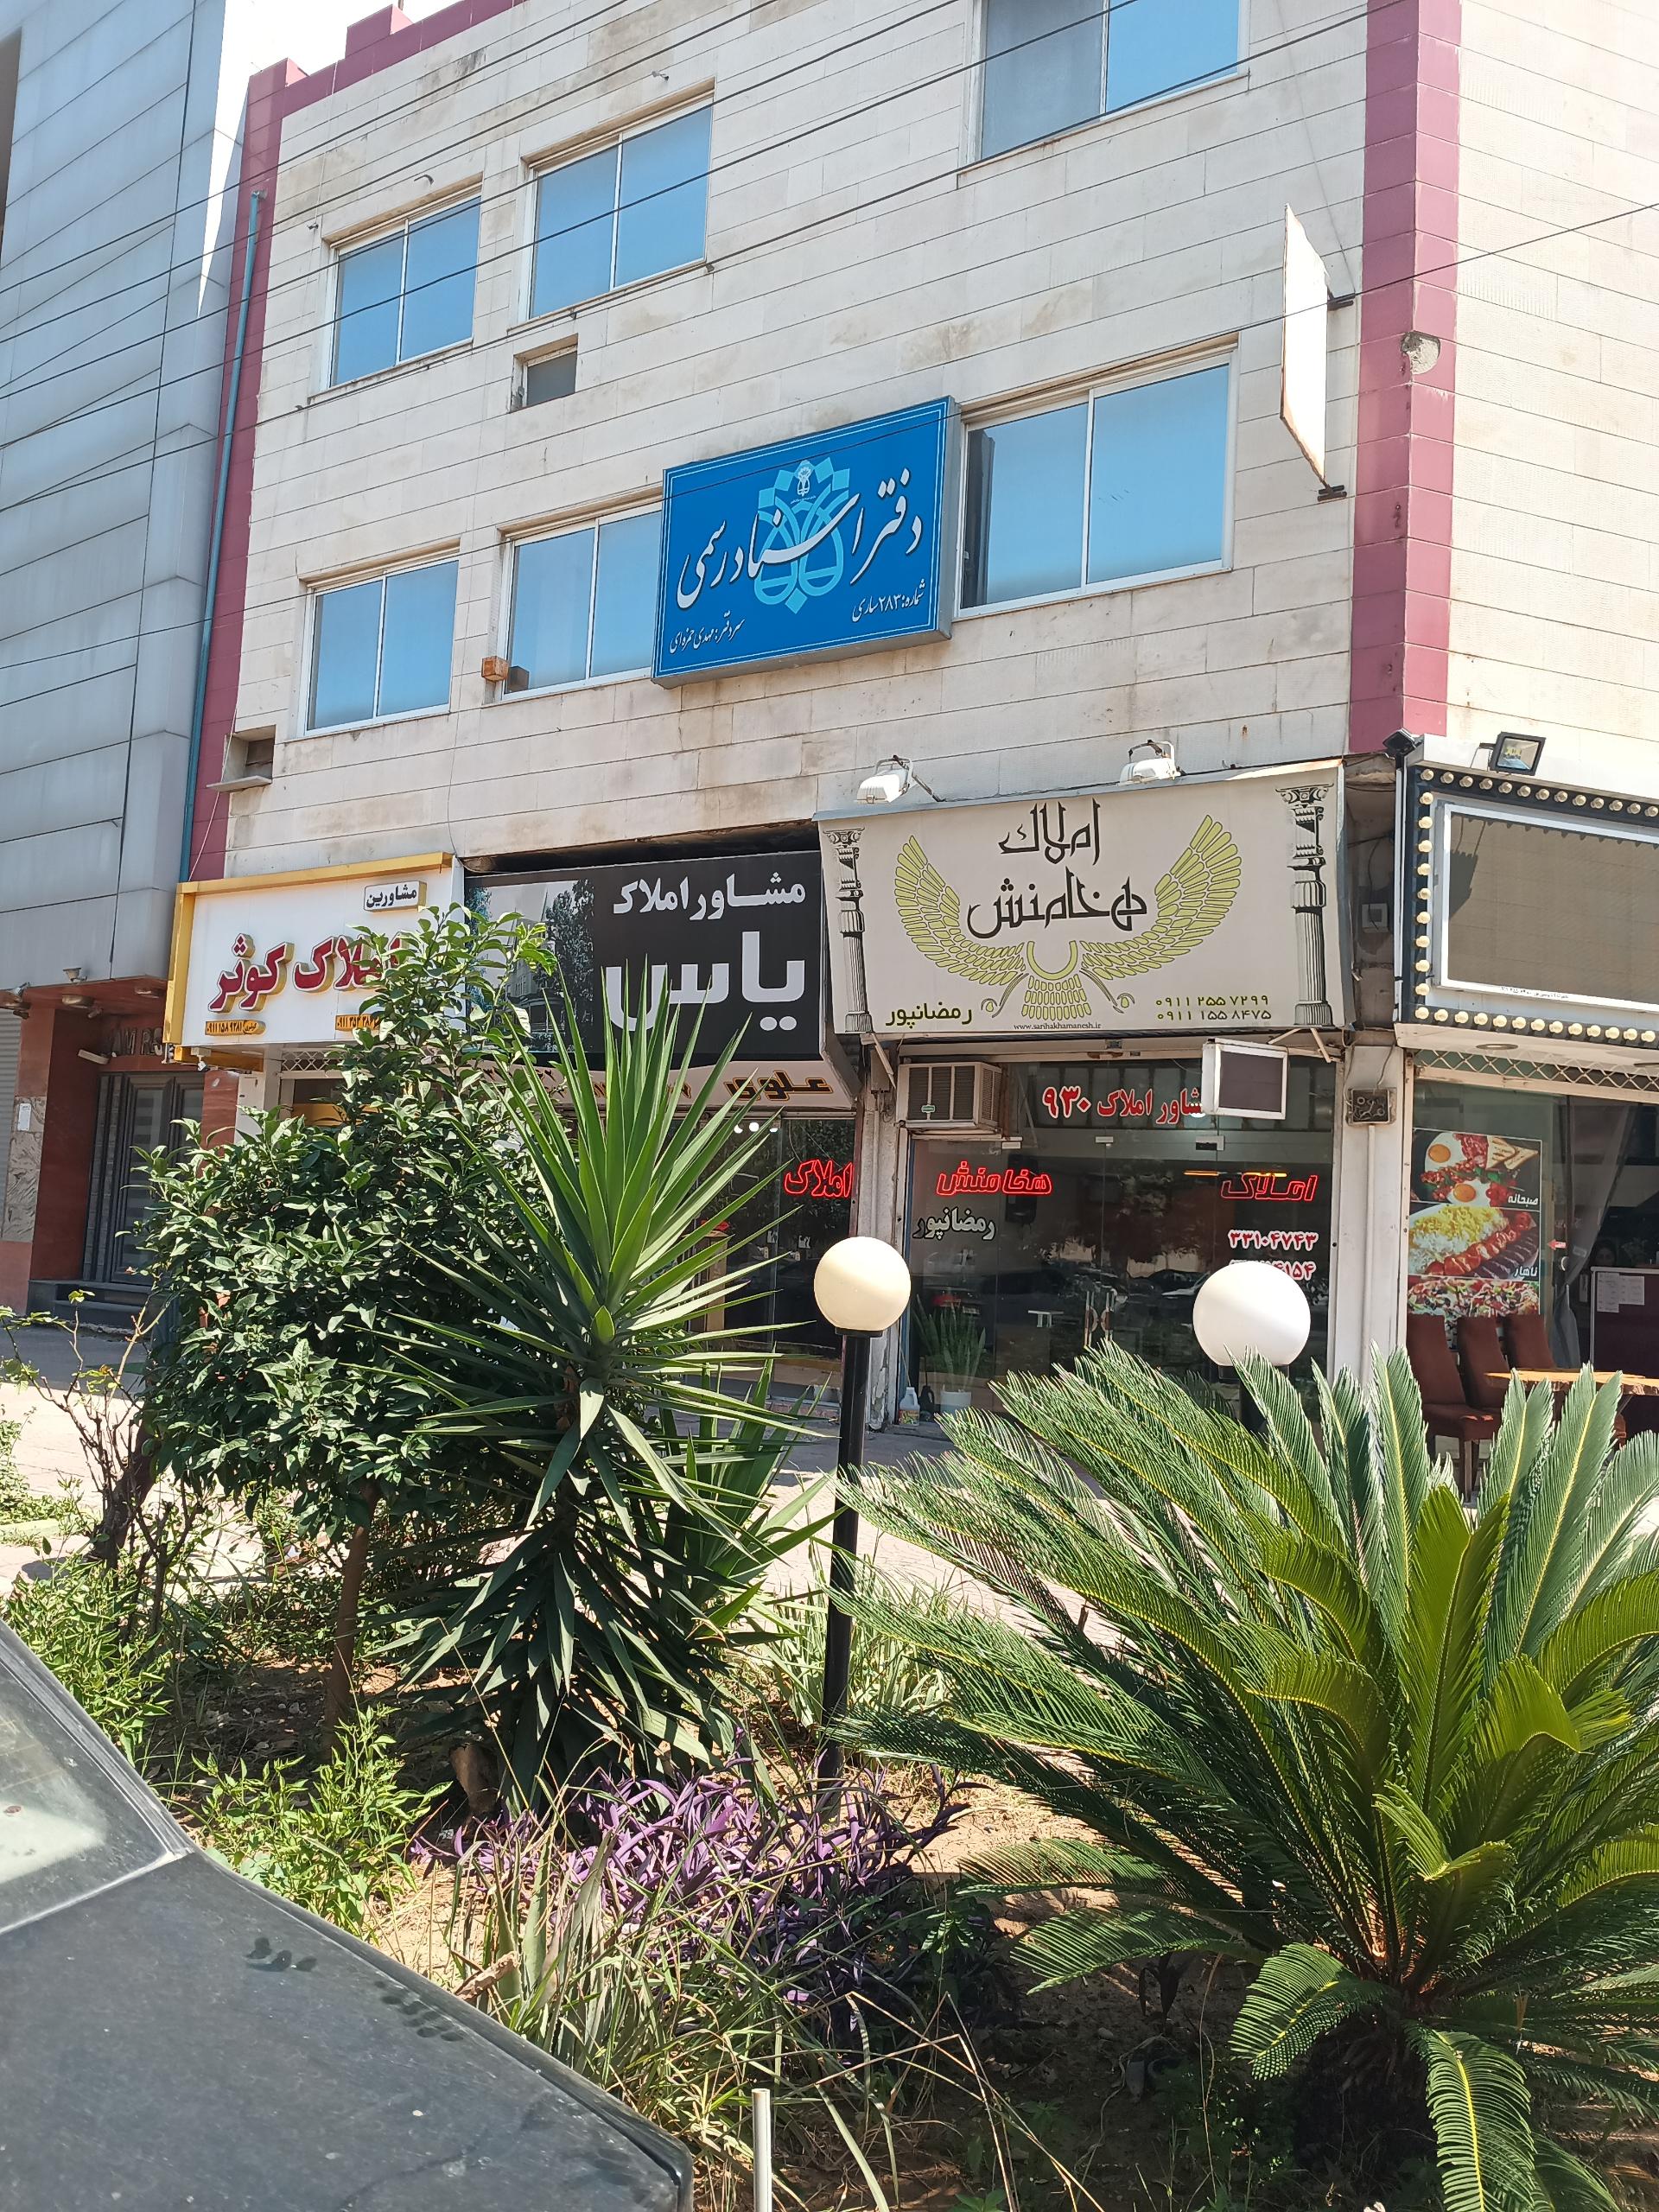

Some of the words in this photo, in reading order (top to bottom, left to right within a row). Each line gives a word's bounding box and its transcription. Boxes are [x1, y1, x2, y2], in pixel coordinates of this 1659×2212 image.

[728, 493, 863, 584] اسناد
[849, 467, 923, 585] دفتر
[677, 520, 728, 609] رسمی
[365, 884, 417, 908] مشاورین
[613, 876, 690, 914] املاک
[690, 872, 806, 921] مشاور
[967, 866, 1147, 939] هخامنش
[207, 932, 290, 1013] کوثر
[605, 931, 805, 1032] یاس
[886, 1001, 973, 1029] رمضانپور
[1013, 1021, 1102, 1031] www.sarihakhamanesh.ir
[723, 1070, 833, 1102] علوی
[1096, 1088, 1153, 1117] املاک
[1155, 1086, 1205, 1125] شاور
[784, 1160, 853, 1198] املاک
[936, 1160, 1053, 1197] هخامنش
[1220, 1173, 1319, 1202] املاک
[1507, 1193, 1539, 1208] صبحانه
[912, 1206, 997, 1242] رمضانپور
[1514, 1265, 1538, 1278] ناهار
